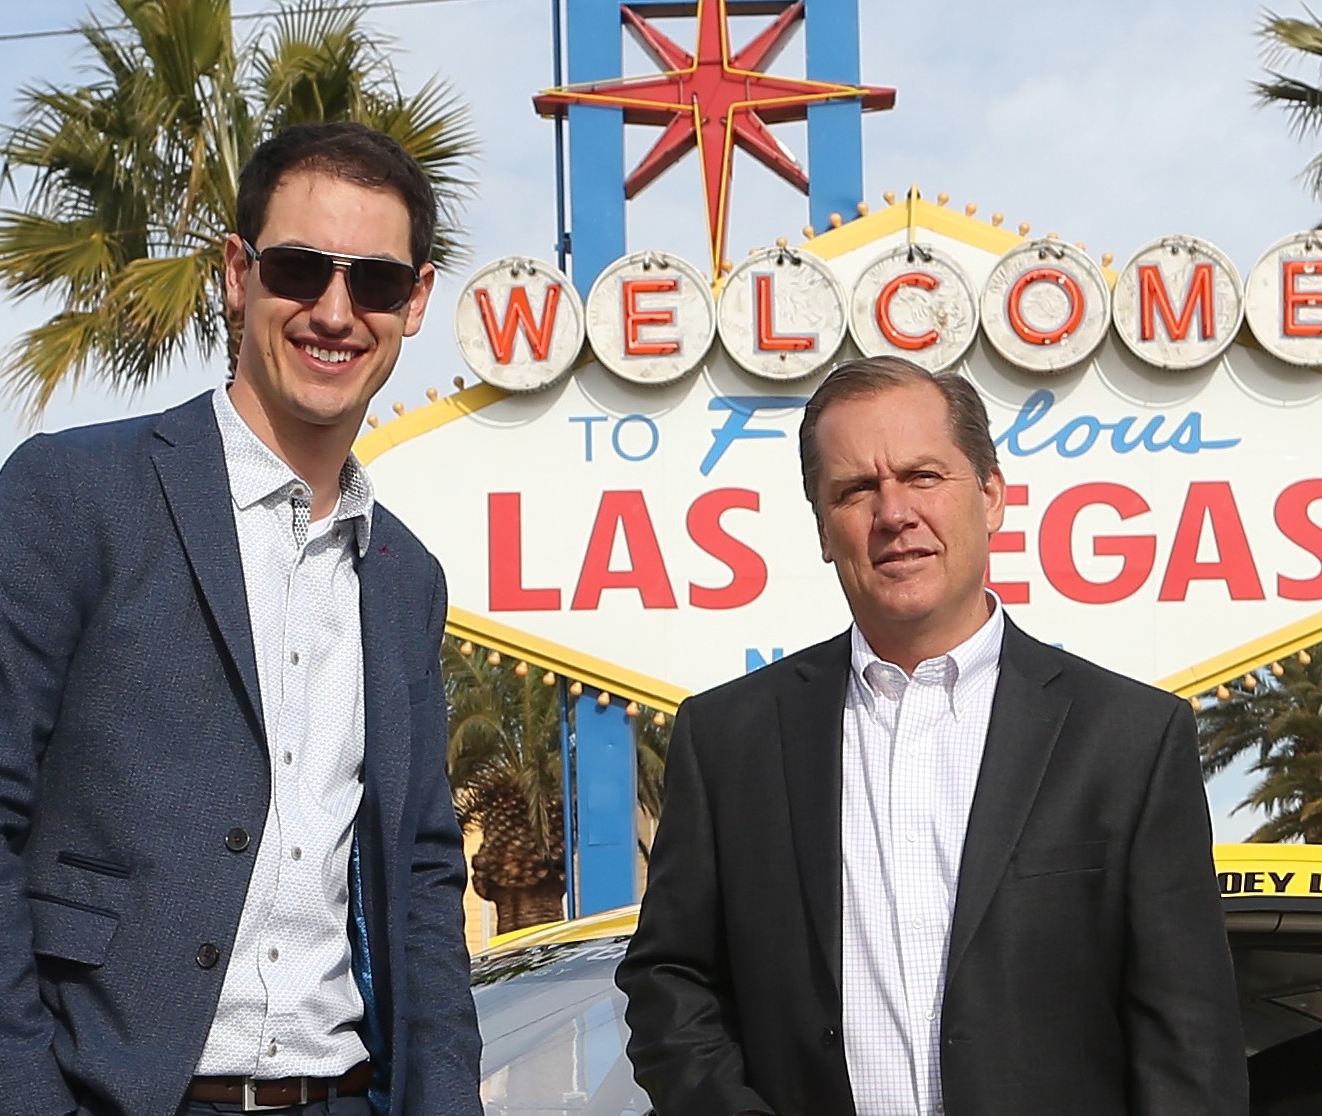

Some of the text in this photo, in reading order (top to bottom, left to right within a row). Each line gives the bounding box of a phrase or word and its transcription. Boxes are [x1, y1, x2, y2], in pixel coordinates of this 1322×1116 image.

[568, 388, 1243, 477] TO Flous
[487, 486, 769, 613] LAS
[1217, 871, 1295, 895] OEY
